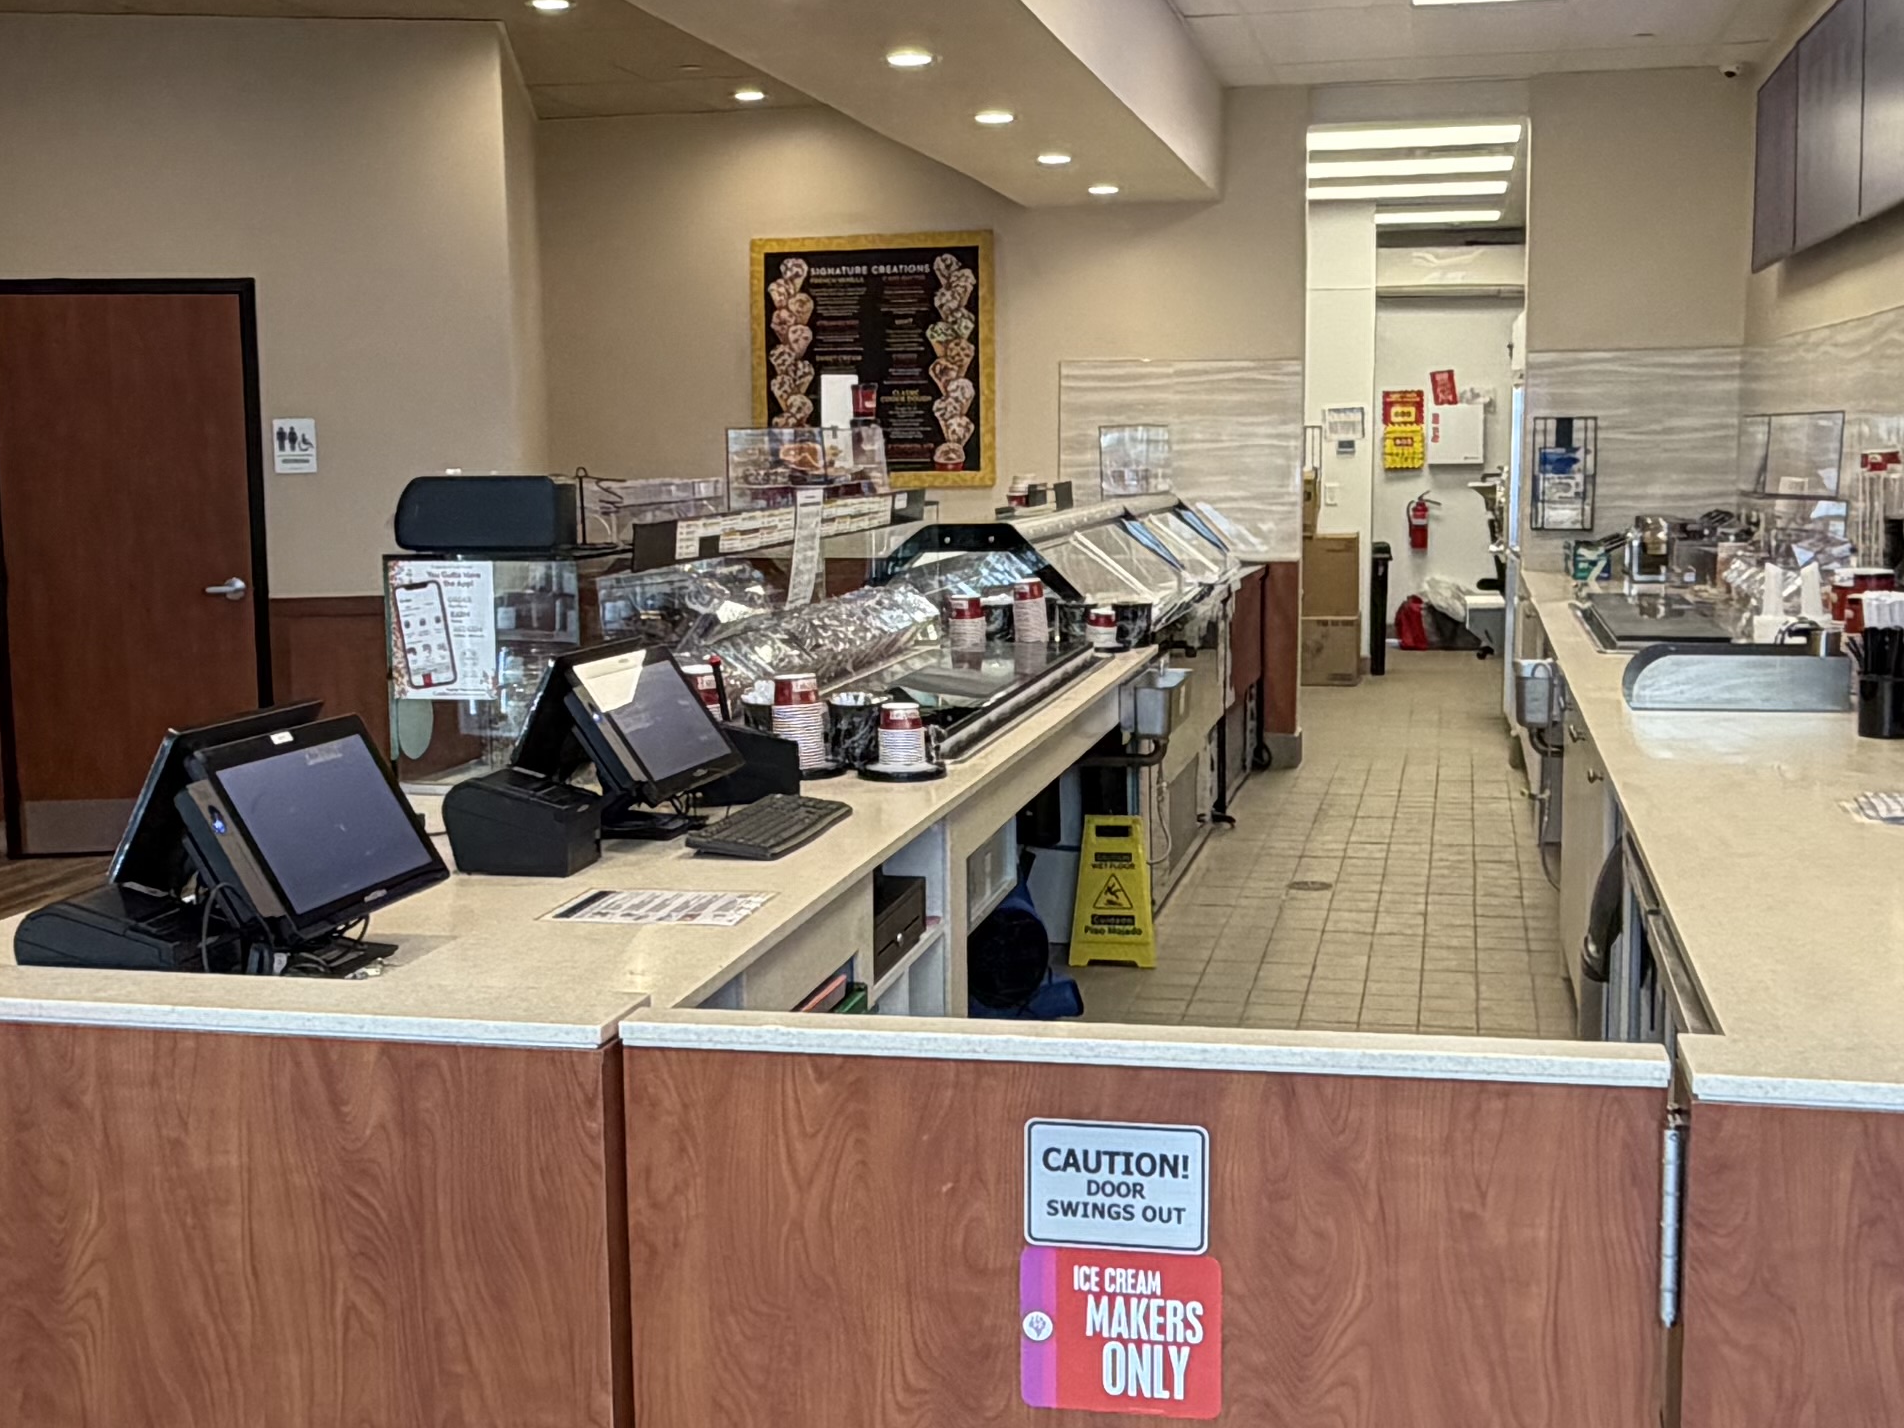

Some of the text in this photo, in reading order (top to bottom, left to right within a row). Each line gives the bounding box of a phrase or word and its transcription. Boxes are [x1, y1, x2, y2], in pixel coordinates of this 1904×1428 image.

[809, 263, 931, 276] SIGNATURE CREATIONS
[1042, 1147, 1190, 1180] CAUTION!
[1086, 1180, 1146, 1200] DOOR
[1046, 1200, 1186, 1225] SWINGS OUT
[1073, 1265, 1162, 1295] ICE CREAM
[1085, 1295, 1205, 1344] MAKERS
[1101, 1341, 1191, 1401] ONLY
